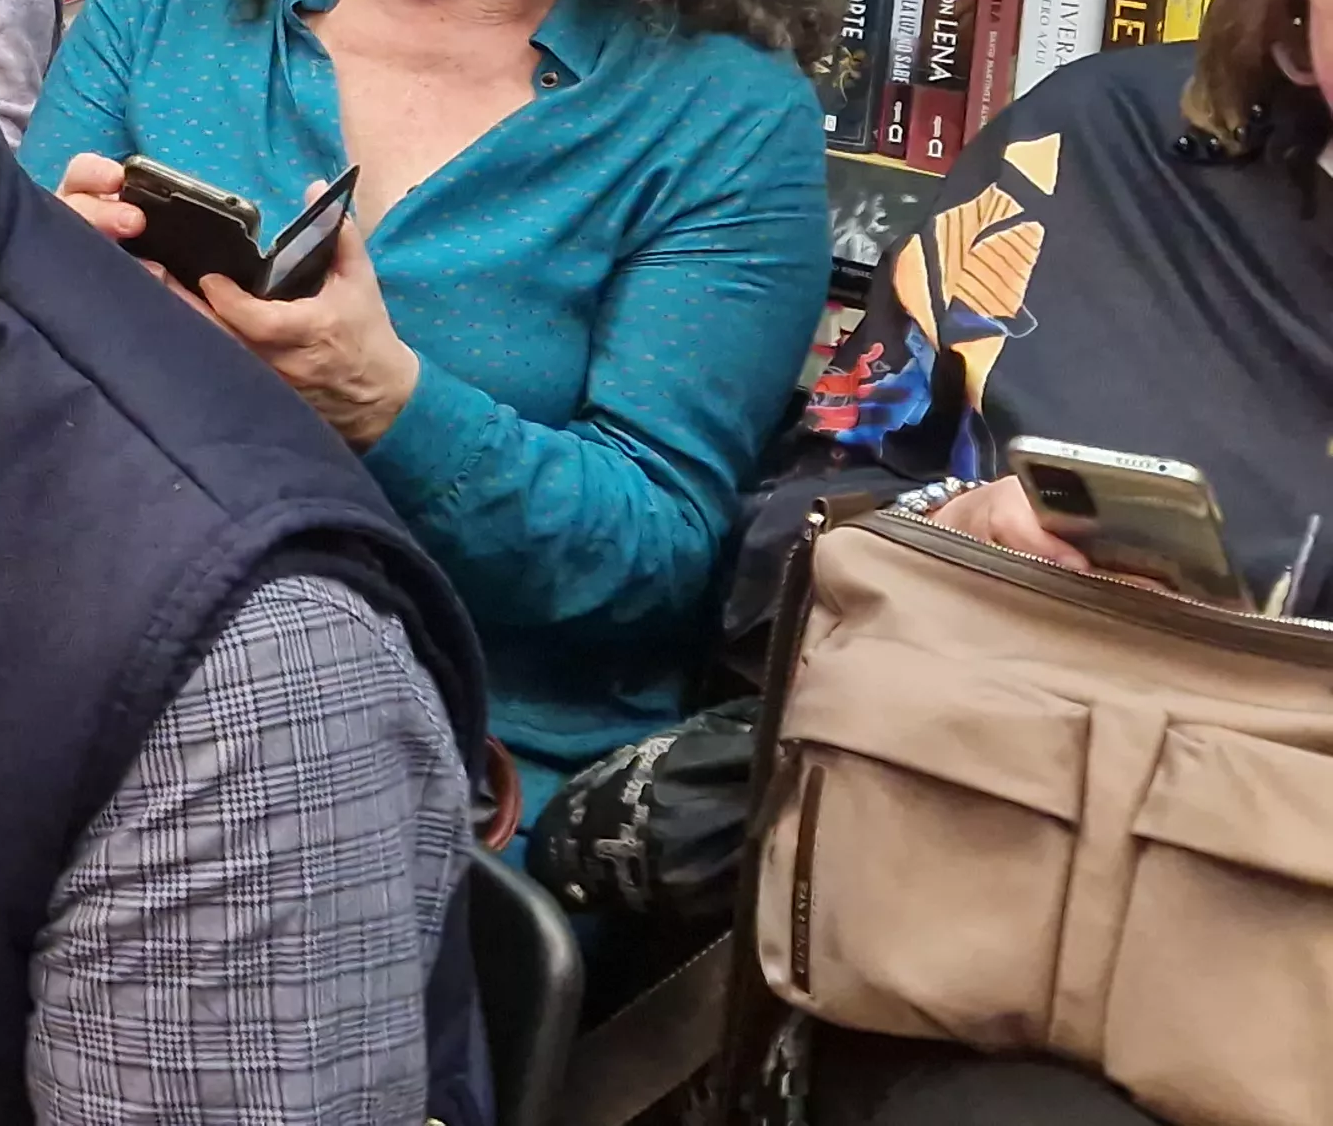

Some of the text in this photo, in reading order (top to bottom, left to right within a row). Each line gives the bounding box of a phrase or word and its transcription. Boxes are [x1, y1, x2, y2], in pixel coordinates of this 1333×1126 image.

[900, 0, 916, 12] LA
[897, 14, 916, 35] LUZ
[928, 18, 956, 82] LENA
[1034, 32, 1048, 64] AZUL
[890, 54, 911, 84] SABE
